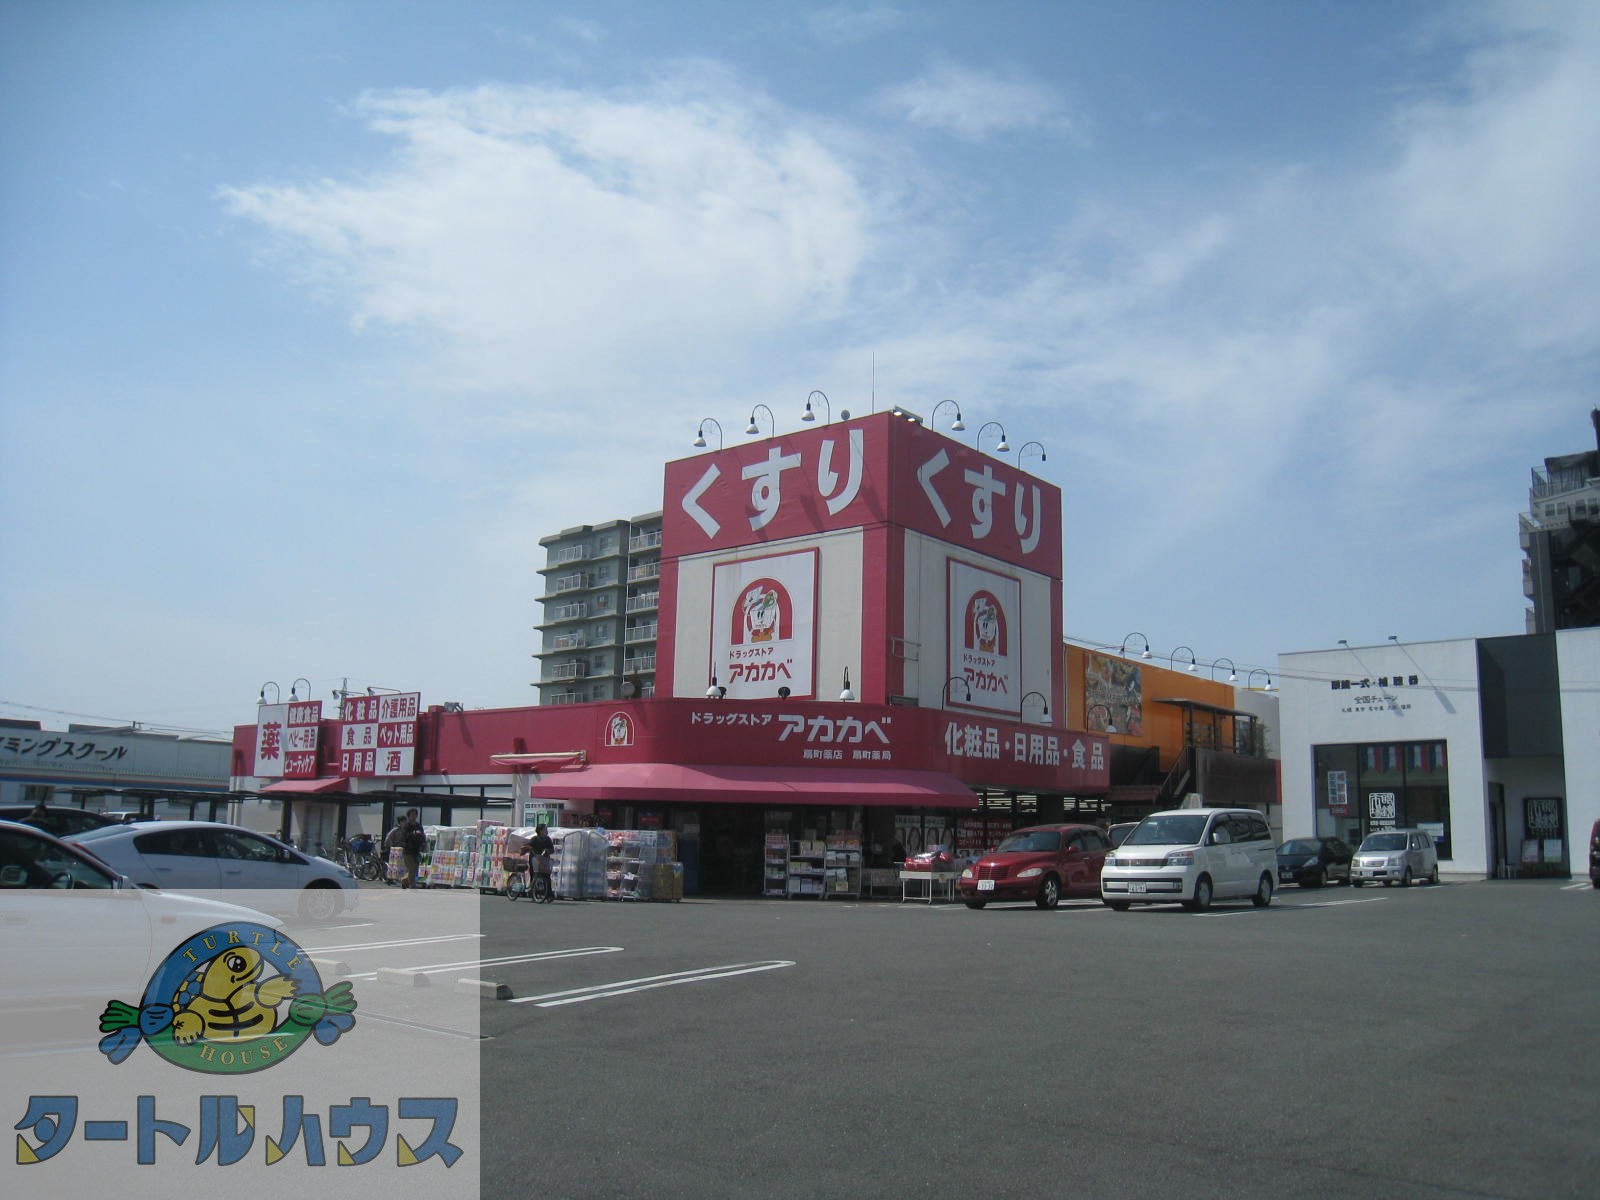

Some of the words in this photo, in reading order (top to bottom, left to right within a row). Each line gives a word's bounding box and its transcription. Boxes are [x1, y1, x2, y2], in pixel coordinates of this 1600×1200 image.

[682, 429, 864, 539] くすり
[917, 448, 1041, 554] くすり
[729, 647, 774, 660] ドラッグストア
[729, 659, 793, 684] アカカベ
[964, 667, 1009, 694] アカカベ
[344, 700, 378, 721] 化粧品
[381, 697, 416, 719] 介護用品
[346, 727, 372, 746] 食品
[379, 724, 414, 744] ペット用品
[691, 712, 773, 726] ドラッグストア
[778, 715, 892, 744] アカカベ
[0, 736, 128, 760] ミングスクール
[261, 721, 282, 760] 薬
[341, 752, 374, 772] 日用品
[386, 751, 402, 772] 酒
